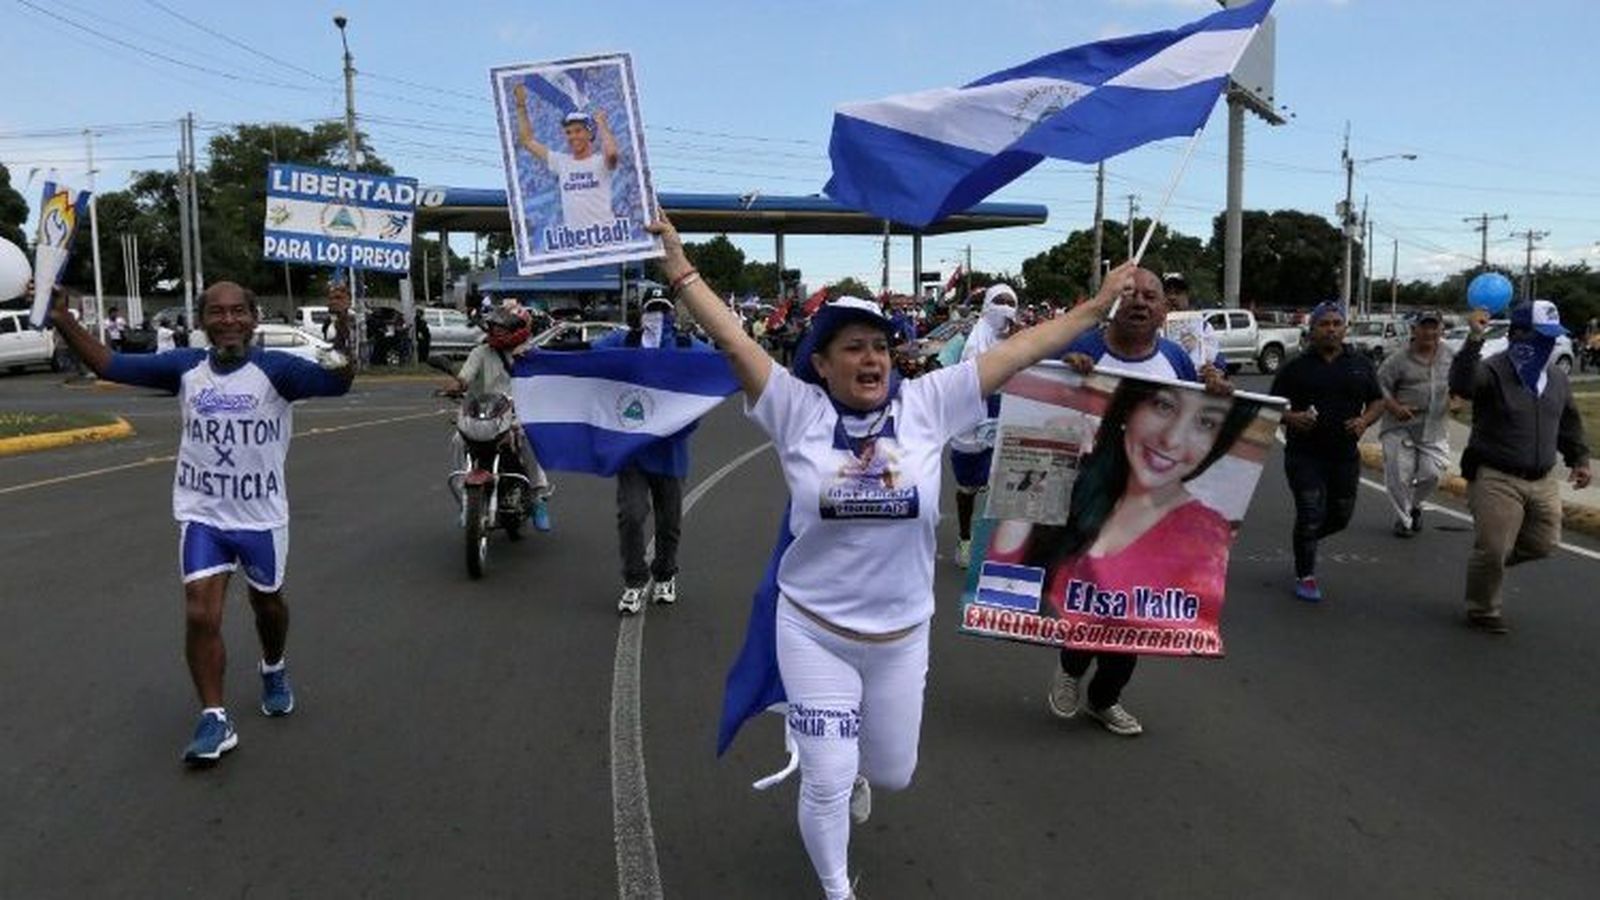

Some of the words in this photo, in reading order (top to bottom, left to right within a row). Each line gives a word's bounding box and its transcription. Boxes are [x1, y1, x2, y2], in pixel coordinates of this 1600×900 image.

[272, 169, 415, 206] LIBERTAD
[264, 236, 312, 261] PARA
[317, 242, 347, 263] LOS
[352, 245, 411, 270] PRESOS
[546, 219, 630, 251] Libertad!
[178, 460, 279, 501] JUSTICIA
[1065, 579, 1127, 618] Elsa
[1134, 586, 1199, 621] Valle
[963, 603, 1072, 643] EXIGIMOS
[1073, 622, 1104, 645] SU
